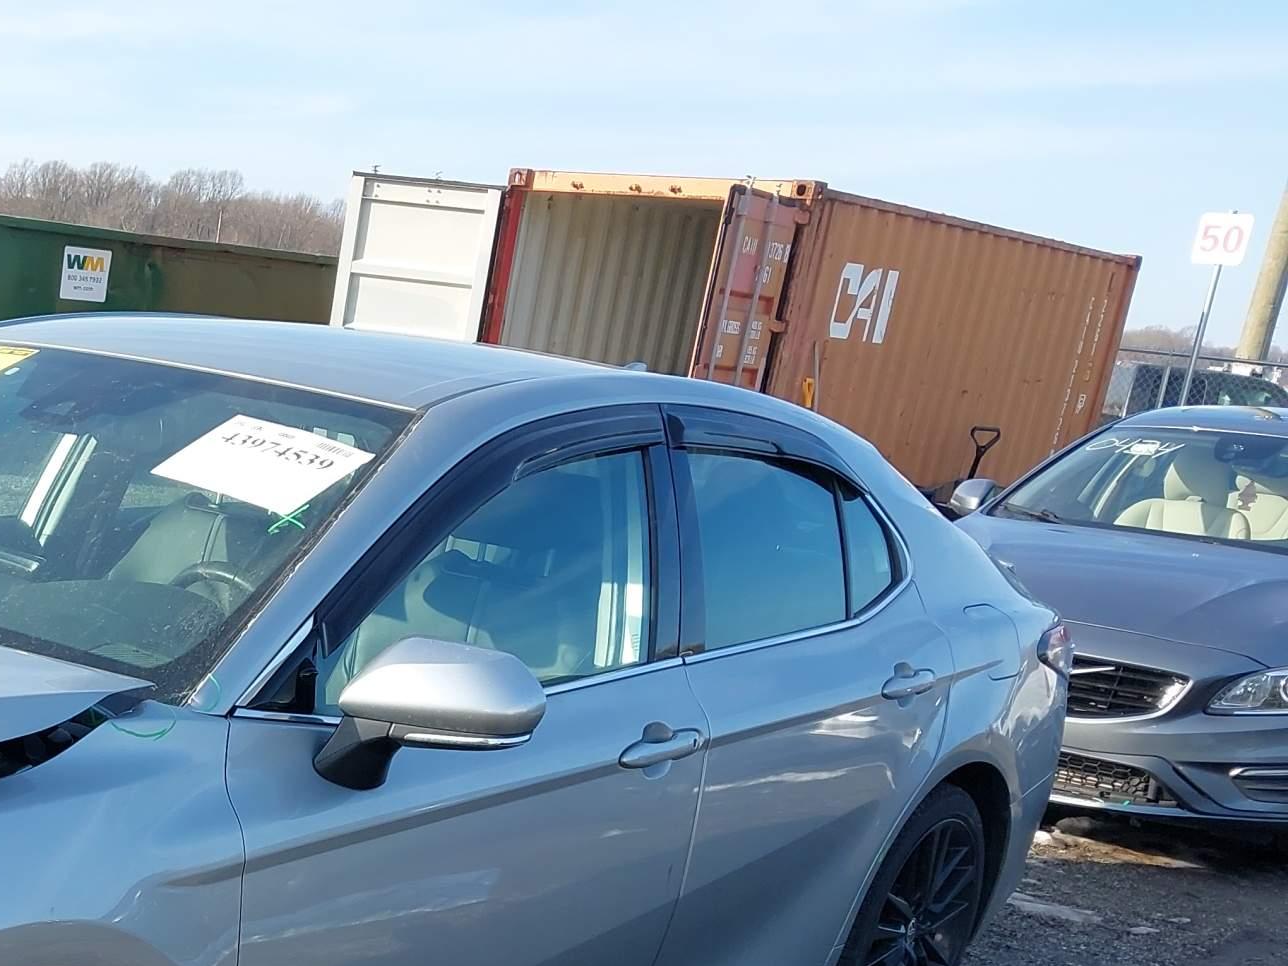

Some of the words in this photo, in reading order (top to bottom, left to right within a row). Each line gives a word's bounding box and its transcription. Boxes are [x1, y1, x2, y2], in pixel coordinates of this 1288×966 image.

[1200, 225, 1244, 253] 50
[67, 254, 105, 272] WM
[829, 262, 900, 344] CAI
[221, 432, 335, 470] 43974539
